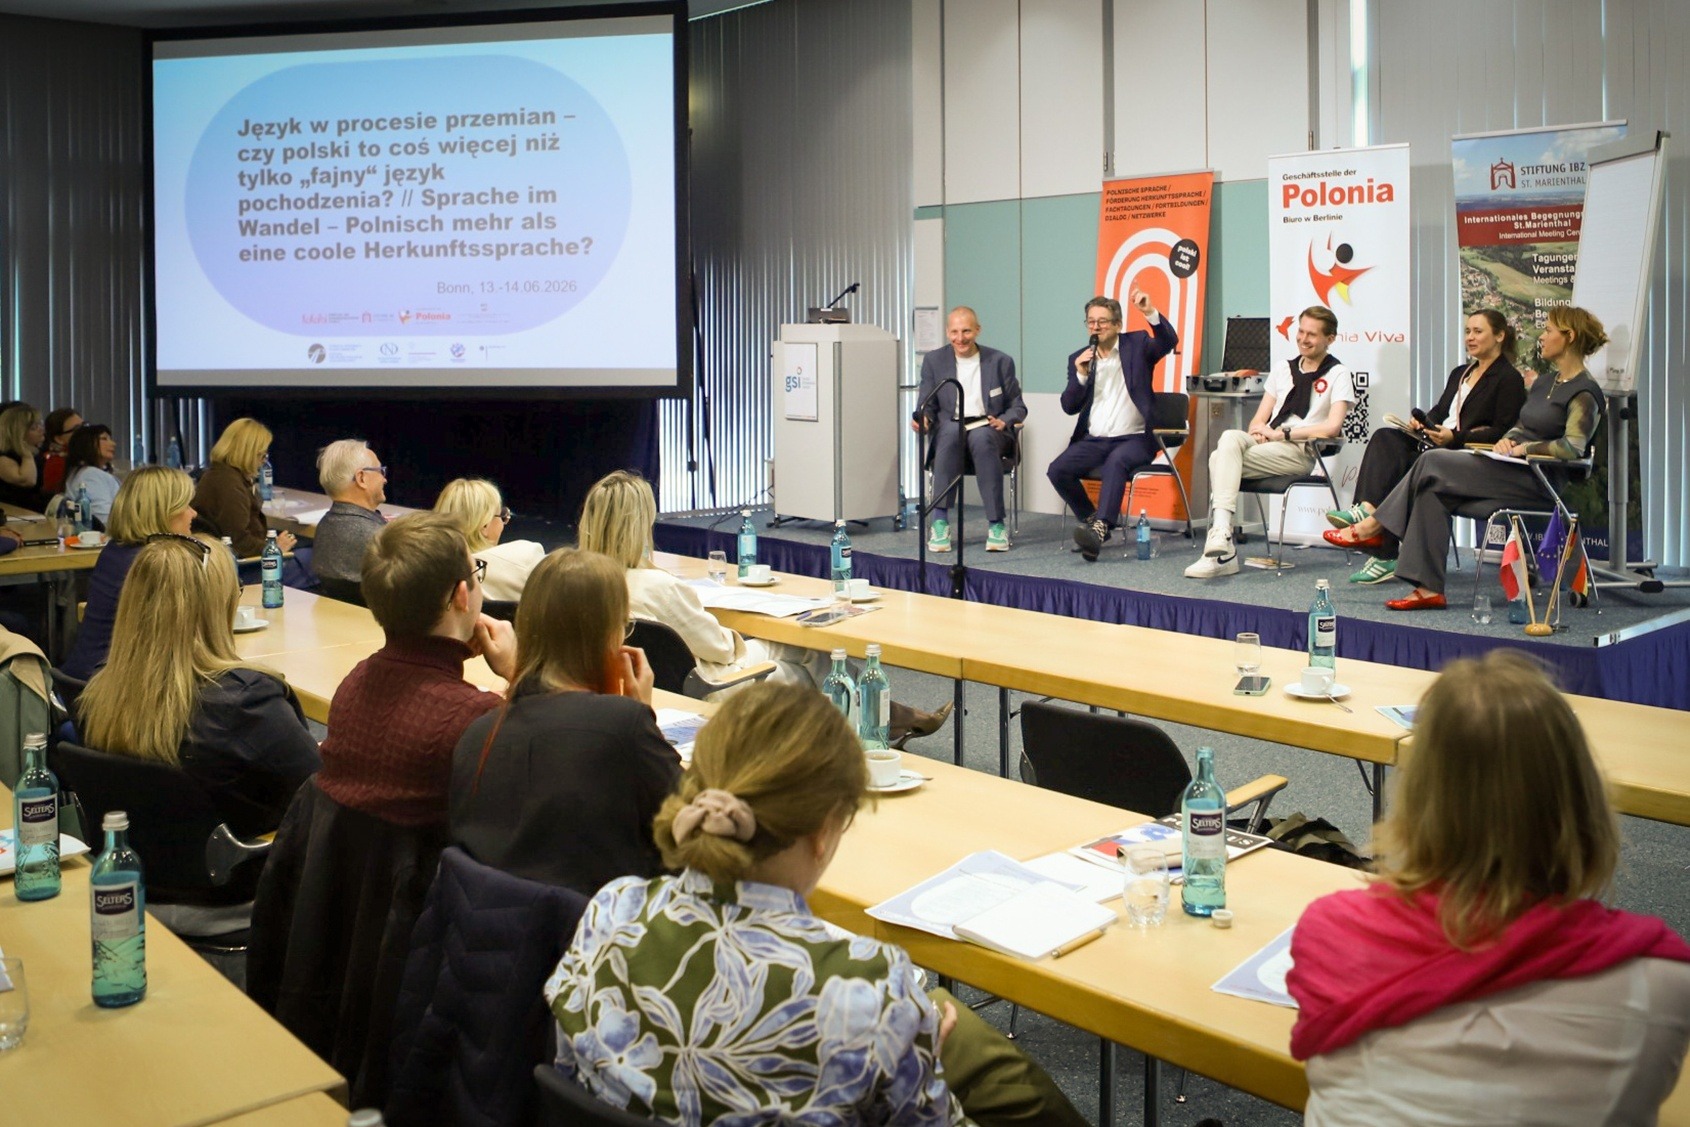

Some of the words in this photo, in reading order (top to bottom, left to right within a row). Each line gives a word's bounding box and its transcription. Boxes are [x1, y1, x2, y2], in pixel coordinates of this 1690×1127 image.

[237, 117, 302, 141] Język
[310, 120, 329, 133] w
[337, 112, 437, 137] procesie
[446, 107, 556, 133] przemian
[237, 147, 275, 165] czy
[282, 141, 350, 164] polski
[358, 140, 381, 157] to
[389, 137, 430, 156] coś
[438, 134, 517, 159] więcej
[526, 132, 560, 151] niż
[1520, 164, 1566, 175] STIFTUNG
[1569, 162, 1586, 172] IBZ
[238, 168, 293, 191] tylko
[383, 163, 445, 187] język
[1282, 170, 1342, 181] Geschäftsstelle
[1521, 180, 1532, 188] ST.
[1535, 177, 1586, 187] MARIENTHAL
[1106, 187, 1139, 195] POLNISCHE
[1140, 185, 1167, 193] SPRACHE
[1282, 178, 1394, 209] Polonia
[238, 190, 394, 217] pochodzenia?
[421, 187, 520, 210] Sprache
[528, 186, 557, 204] im
[1140, 191, 1202, 202] HERKUNFTSSPRACHE
[1105, 203, 1151, 212] FACHTAGUNGEN
[1155, 200, 1205, 209] FORTBILDUNGEN
[1131, 211, 1166, 220] NETZWERKE
[1283, 216, 1302, 224] Biuro
[1313, 213, 1343, 222] Berlinie
[1464, 213, 1528, 224] Internationales
[238, 217, 320, 237] Wandel
[346, 215, 444, 234] Polnisch
[452, 213, 514, 231] mehr
[521, 212, 557, 230] als
[1499, 229, 1538, 239] International
[1539, 230, 1565, 239] Meeting
[239, 244, 286, 262] eine
[294, 242, 356, 261] coole
[364, 236, 594, 261] Herkunftssprache?
[1532, 264, 1575, 274] Veransta
[1533, 276, 1568, 285] Meetings
[437, 281, 475, 295] Bonn,
[415, 312, 452, 320] Polonia
[1364, 331, 1405, 342] Viva
[785, 373, 801, 393] gsi
